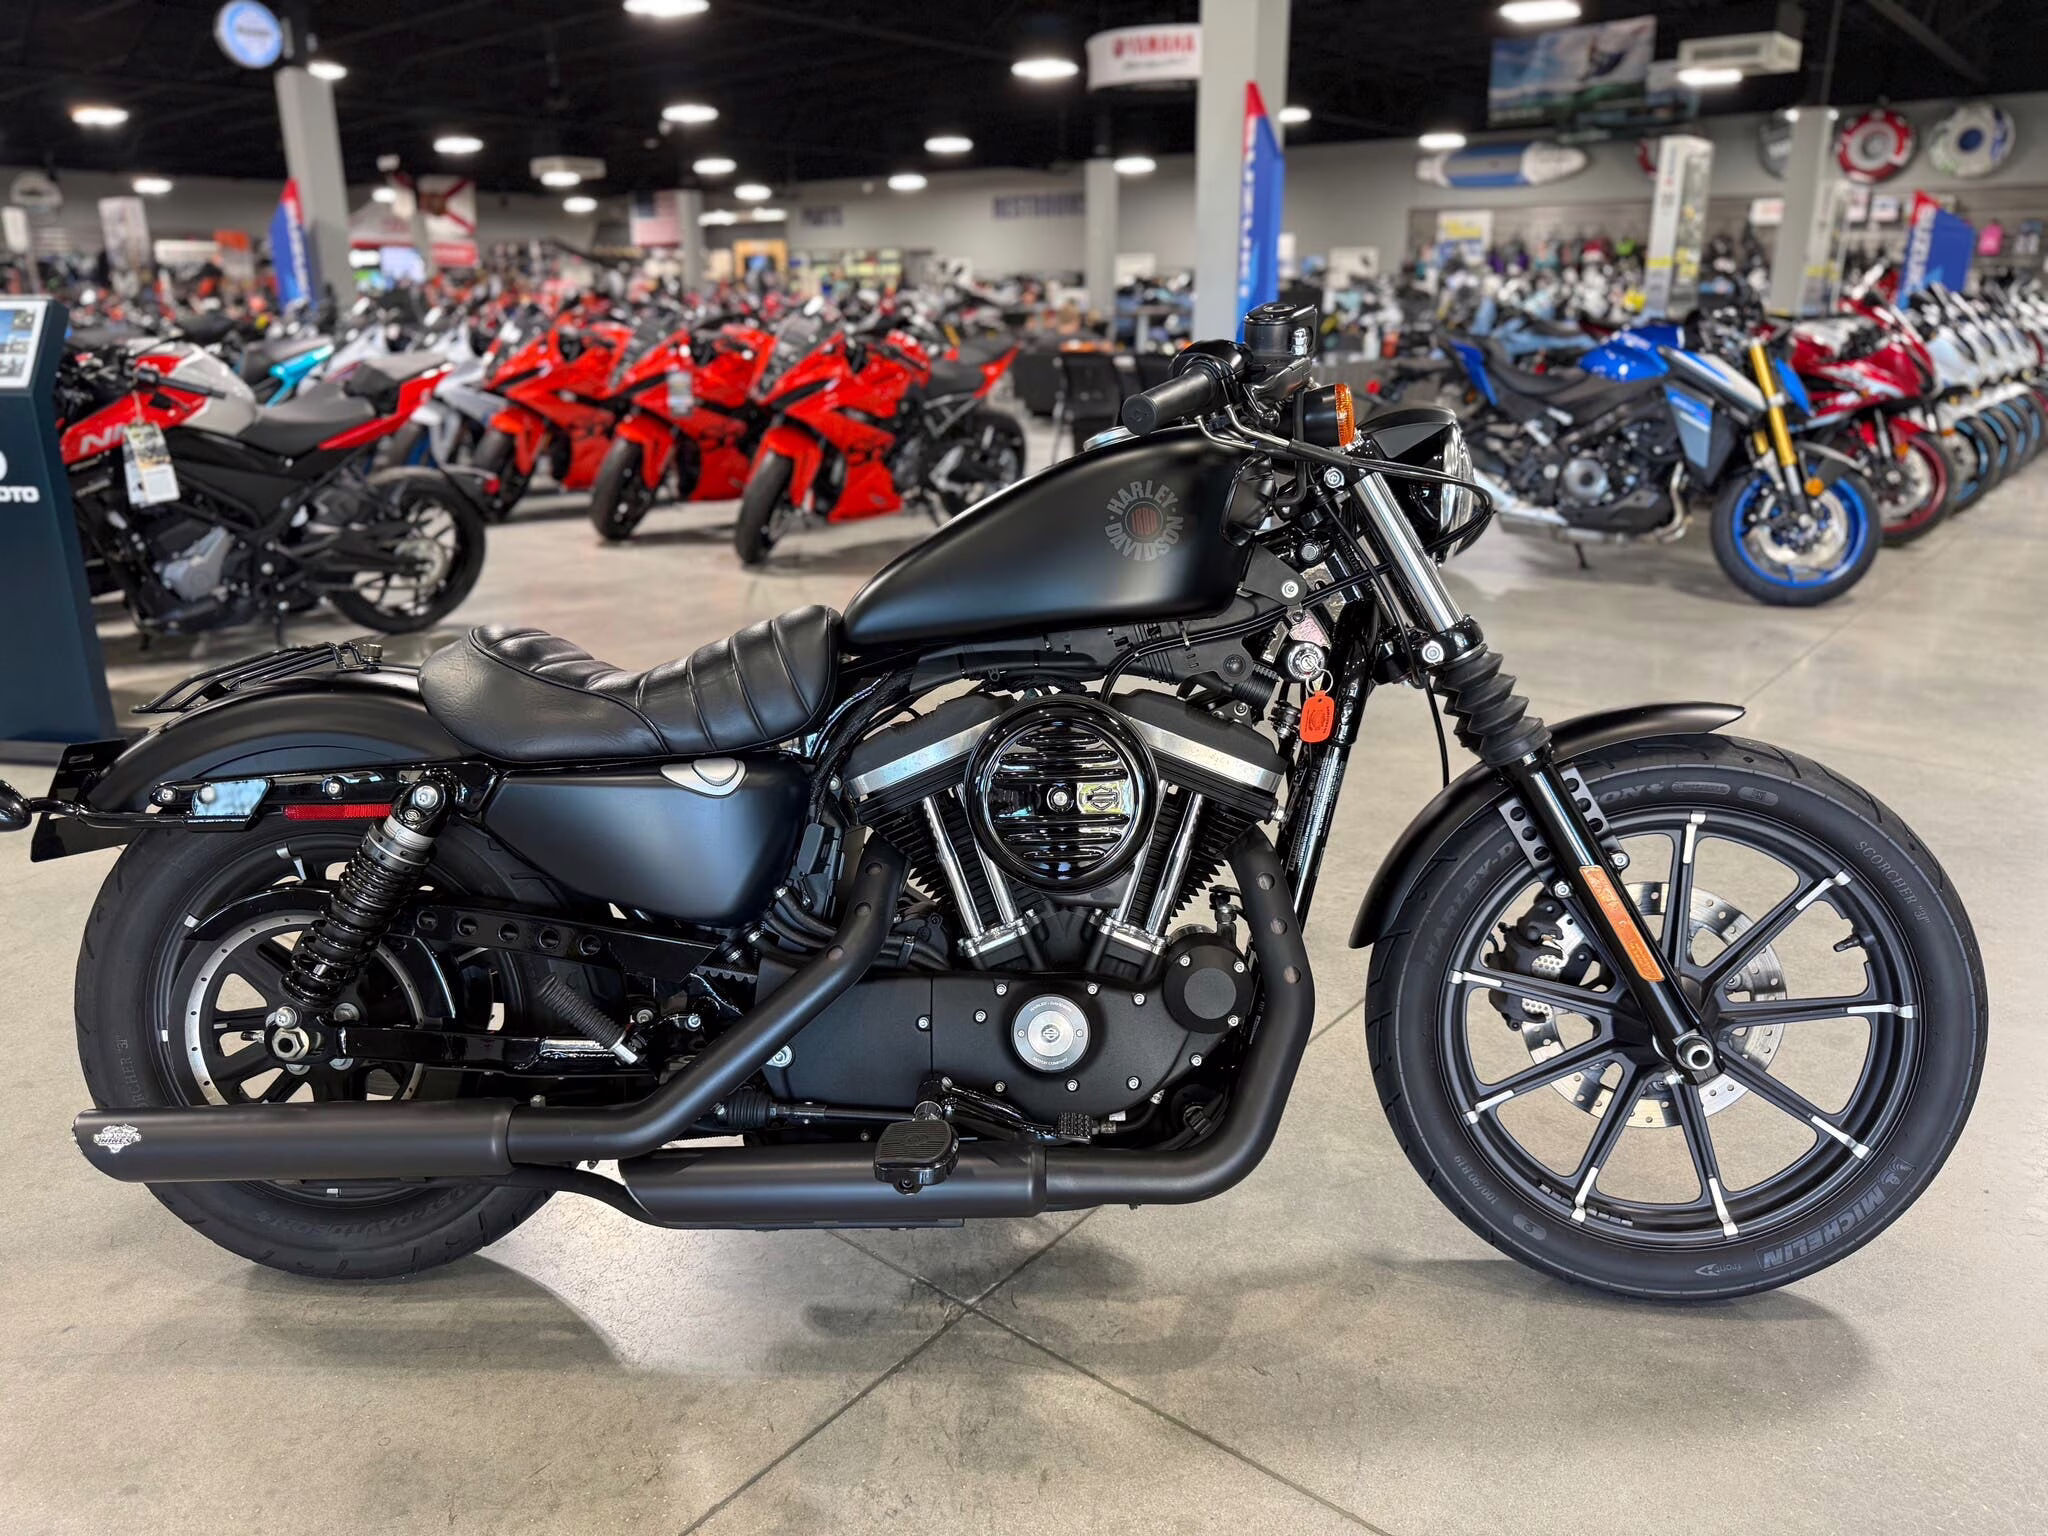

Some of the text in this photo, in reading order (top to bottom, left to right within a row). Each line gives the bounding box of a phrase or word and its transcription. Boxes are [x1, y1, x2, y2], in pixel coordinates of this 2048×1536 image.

[1106, 479, 1179, 516] HARLEY
[1104, 515, 1184, 561] DAVIDSON
[1856, 841, 1918, 905] SCORCHER
[1762, 1184, 1886, 1268] MICHELIN
